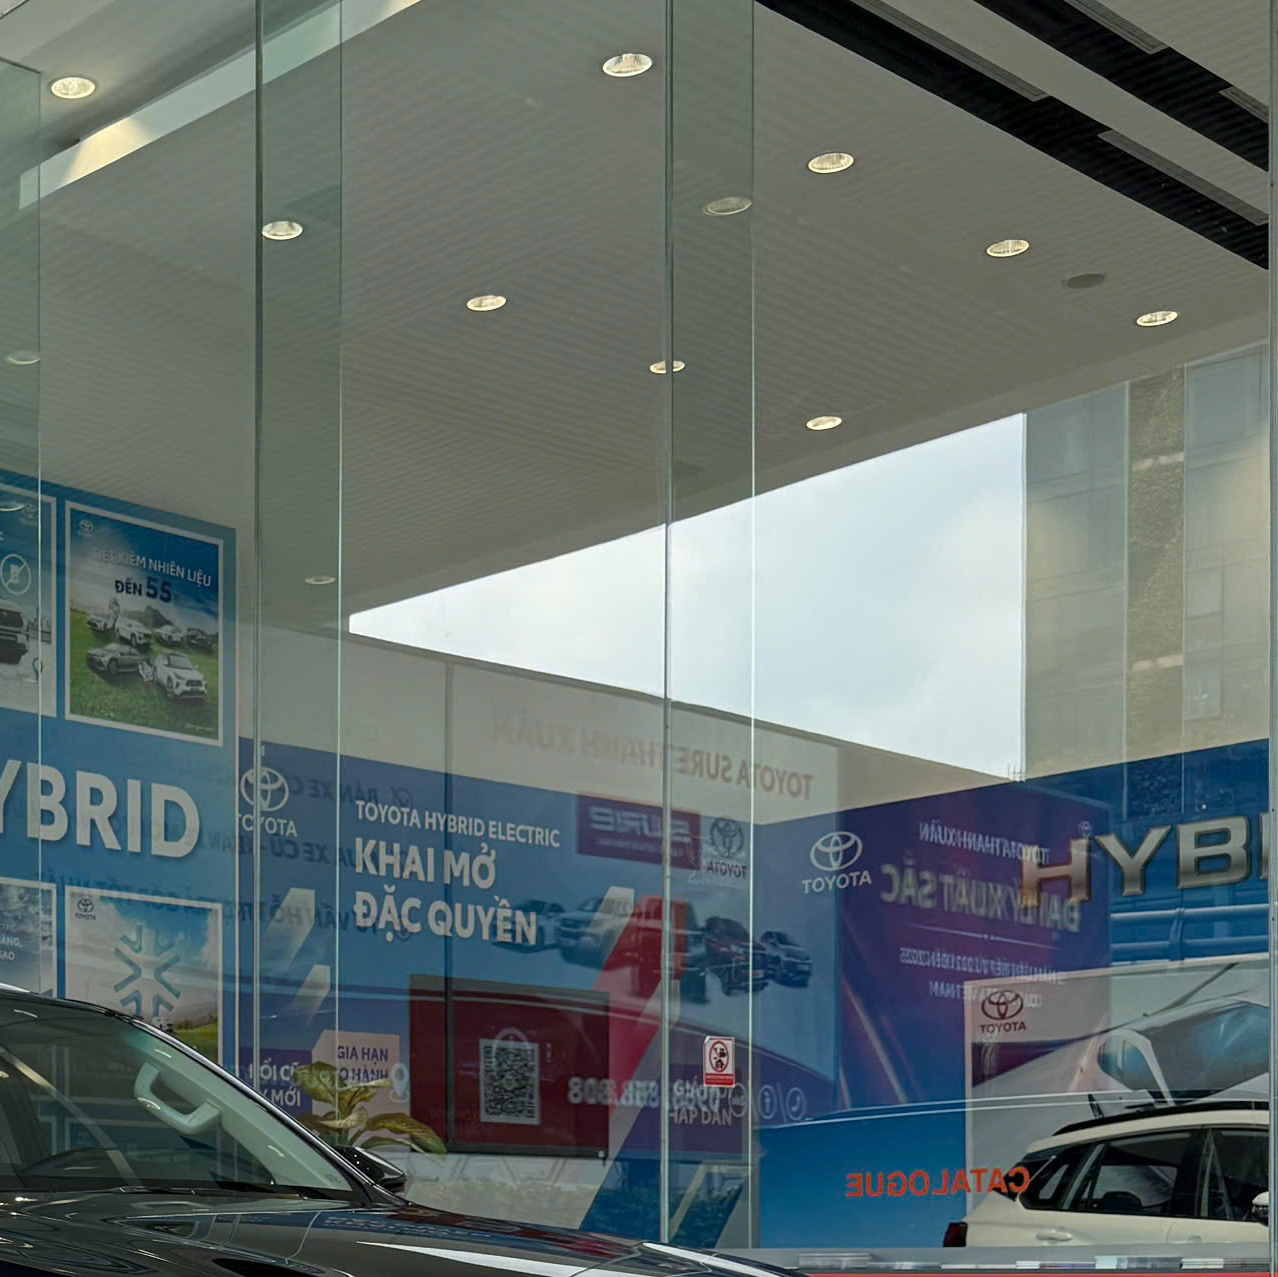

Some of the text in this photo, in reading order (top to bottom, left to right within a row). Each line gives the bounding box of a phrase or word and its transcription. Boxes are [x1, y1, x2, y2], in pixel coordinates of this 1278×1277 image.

[148, 558, 185, 579] NHIÊN
[187, 569, 212, 587] LIỆU
[114, 577, 142, 596] ĐẾN
[356, 800, 421, 829] TOYOTA
[425, 811, 485, 838] HYBRID
[488, 820, 561, 848] ELECTRIC
[354, 837, 435, 883] KHAI
[443, 842, 497, 889] MỞ
[1020, 812, 1270, 910] HYB
[802, 870, 873, 895] TOYOTA
[354, 884, 537, 945] ĐẶC QUYỀN
[980, 1021, 1027, 1034] TOYOTA
[337, 1045, 388, 1067] GIA HẠN
[272, 1085, 301, 1107] MỚI
